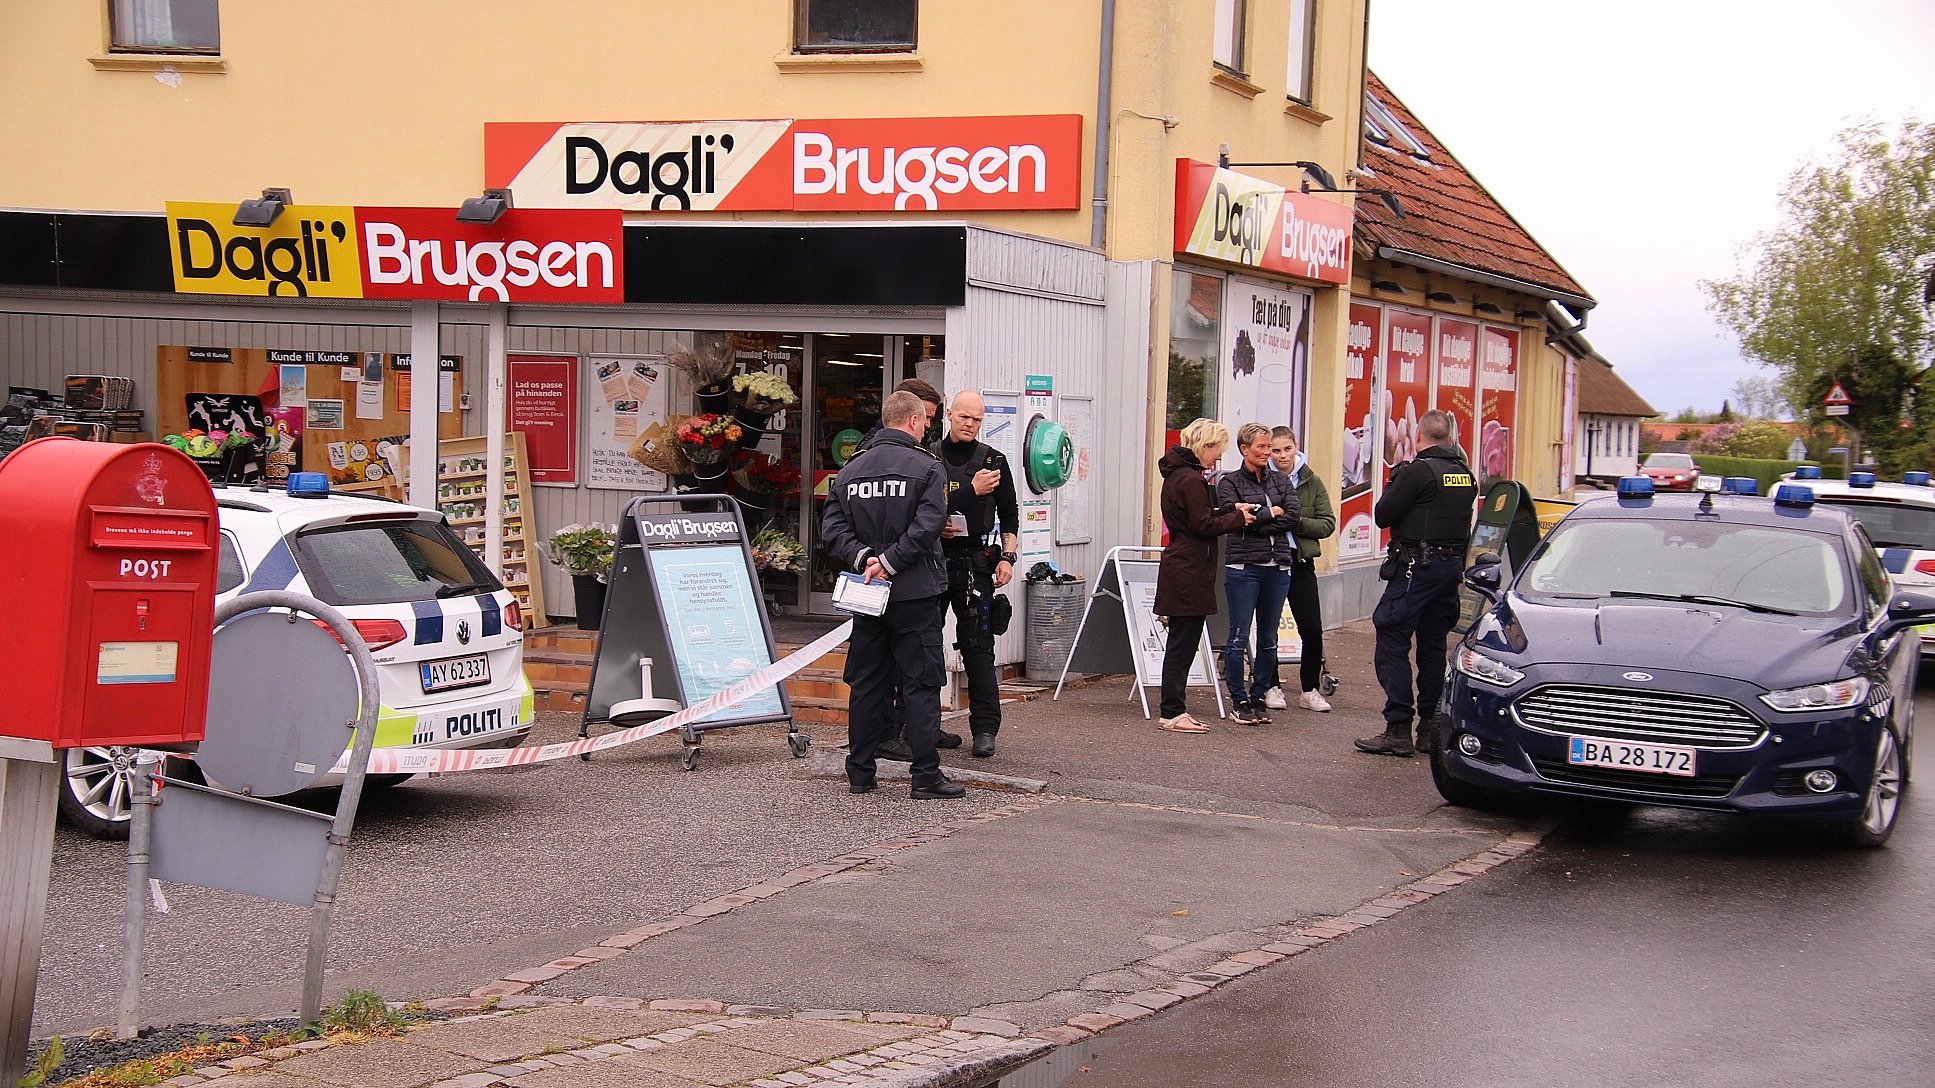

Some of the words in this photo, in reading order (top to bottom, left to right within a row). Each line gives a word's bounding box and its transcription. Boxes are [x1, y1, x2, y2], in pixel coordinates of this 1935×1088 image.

[565, 133, 735, 211] Dagli'
[793, 132, 1047, 211] Brugsen
[1213, 181, 1269, 265] Dagli'
[1281, 201, 1345, 279] Brugsen
[176, 218, 346, 298] Dagli'
[364, 222, 614, 302] Brugsen
[1251, 294, 1266, 325] Tæt
[1267, 294, 1278, 329] på
[1278, 299, 1292, 332] dig
[271, 352, 302, 362] Kunde
[305, 352, 315, 362] til
[317, 353, 349, 363] Kunde
[735, 350, 762, 359] Mandag
[767, 351, 791, 360] Fredag
[515, 381, 529, 389] Lad
[541, 382, 563, 390] passe
[515, 389, 525, 398] på
[526, 389, 562, 397] hinanden
[847, 480, 906, 501] POLITI
[1445, 475, 1471, 485] POLITI
[119, 558, 171, 579] POST
[432, 664, 447, 684] AY
[450, 662, 465, 681] 62
[466, 659, 486, 679] 337
[446, 707, 502, 739] POLITI
[1585, 743, 1613, 763] BA
[1619, 746, 1645, 767] 28
[1652, 750, 1691, 771] 172
